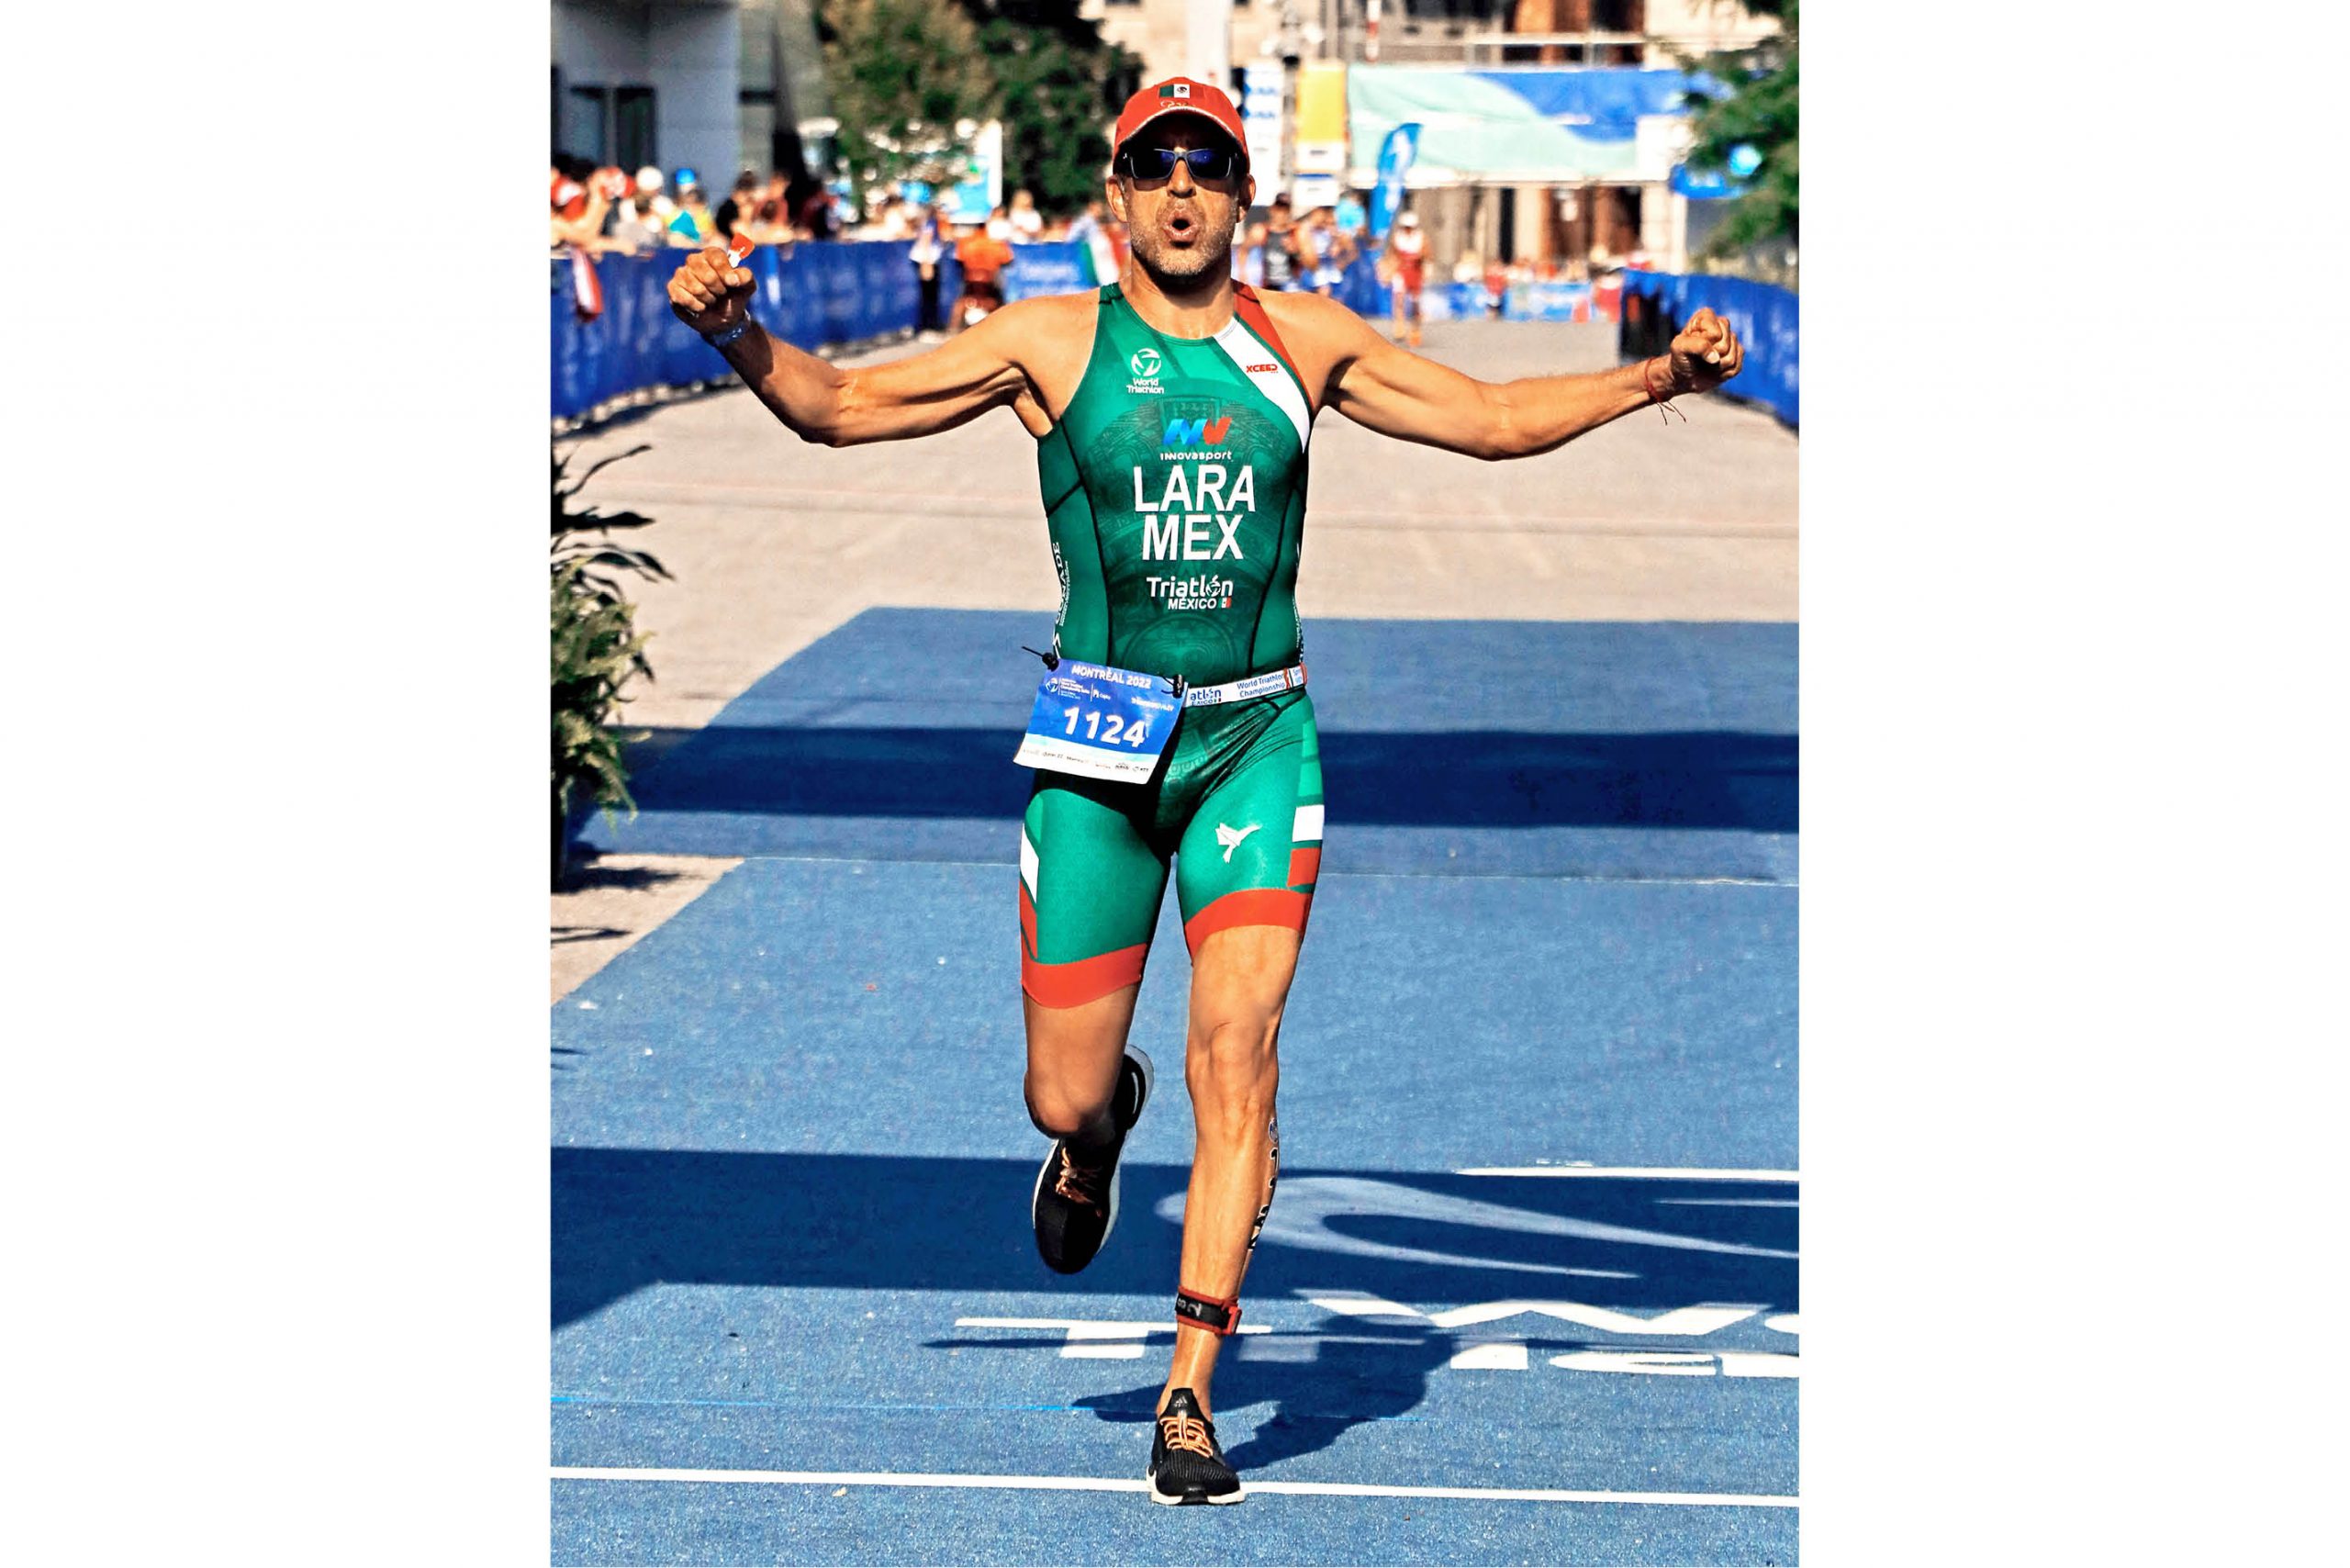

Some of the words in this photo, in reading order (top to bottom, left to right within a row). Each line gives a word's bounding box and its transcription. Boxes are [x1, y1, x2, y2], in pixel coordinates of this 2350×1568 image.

[1126, 385, 1164, 394] Triathlon
[1133, 377, 1159, 386] World
[1134, 465, 1256, 512] LARA
[1142, 514, 1244, 560] MEX
[1147, 575, 1234, 598] Triatlón
[1168, 596, 1217, 610] MÉXICO
[1071, 665, 1125, 684] MONTRÉAL
[1127, 675, 1152, 689] 2022
[1237, 679, 1258, 689] World
[1239, 681, 1285, 698] Championship
[1064, 706, 1146, 748] 1124
